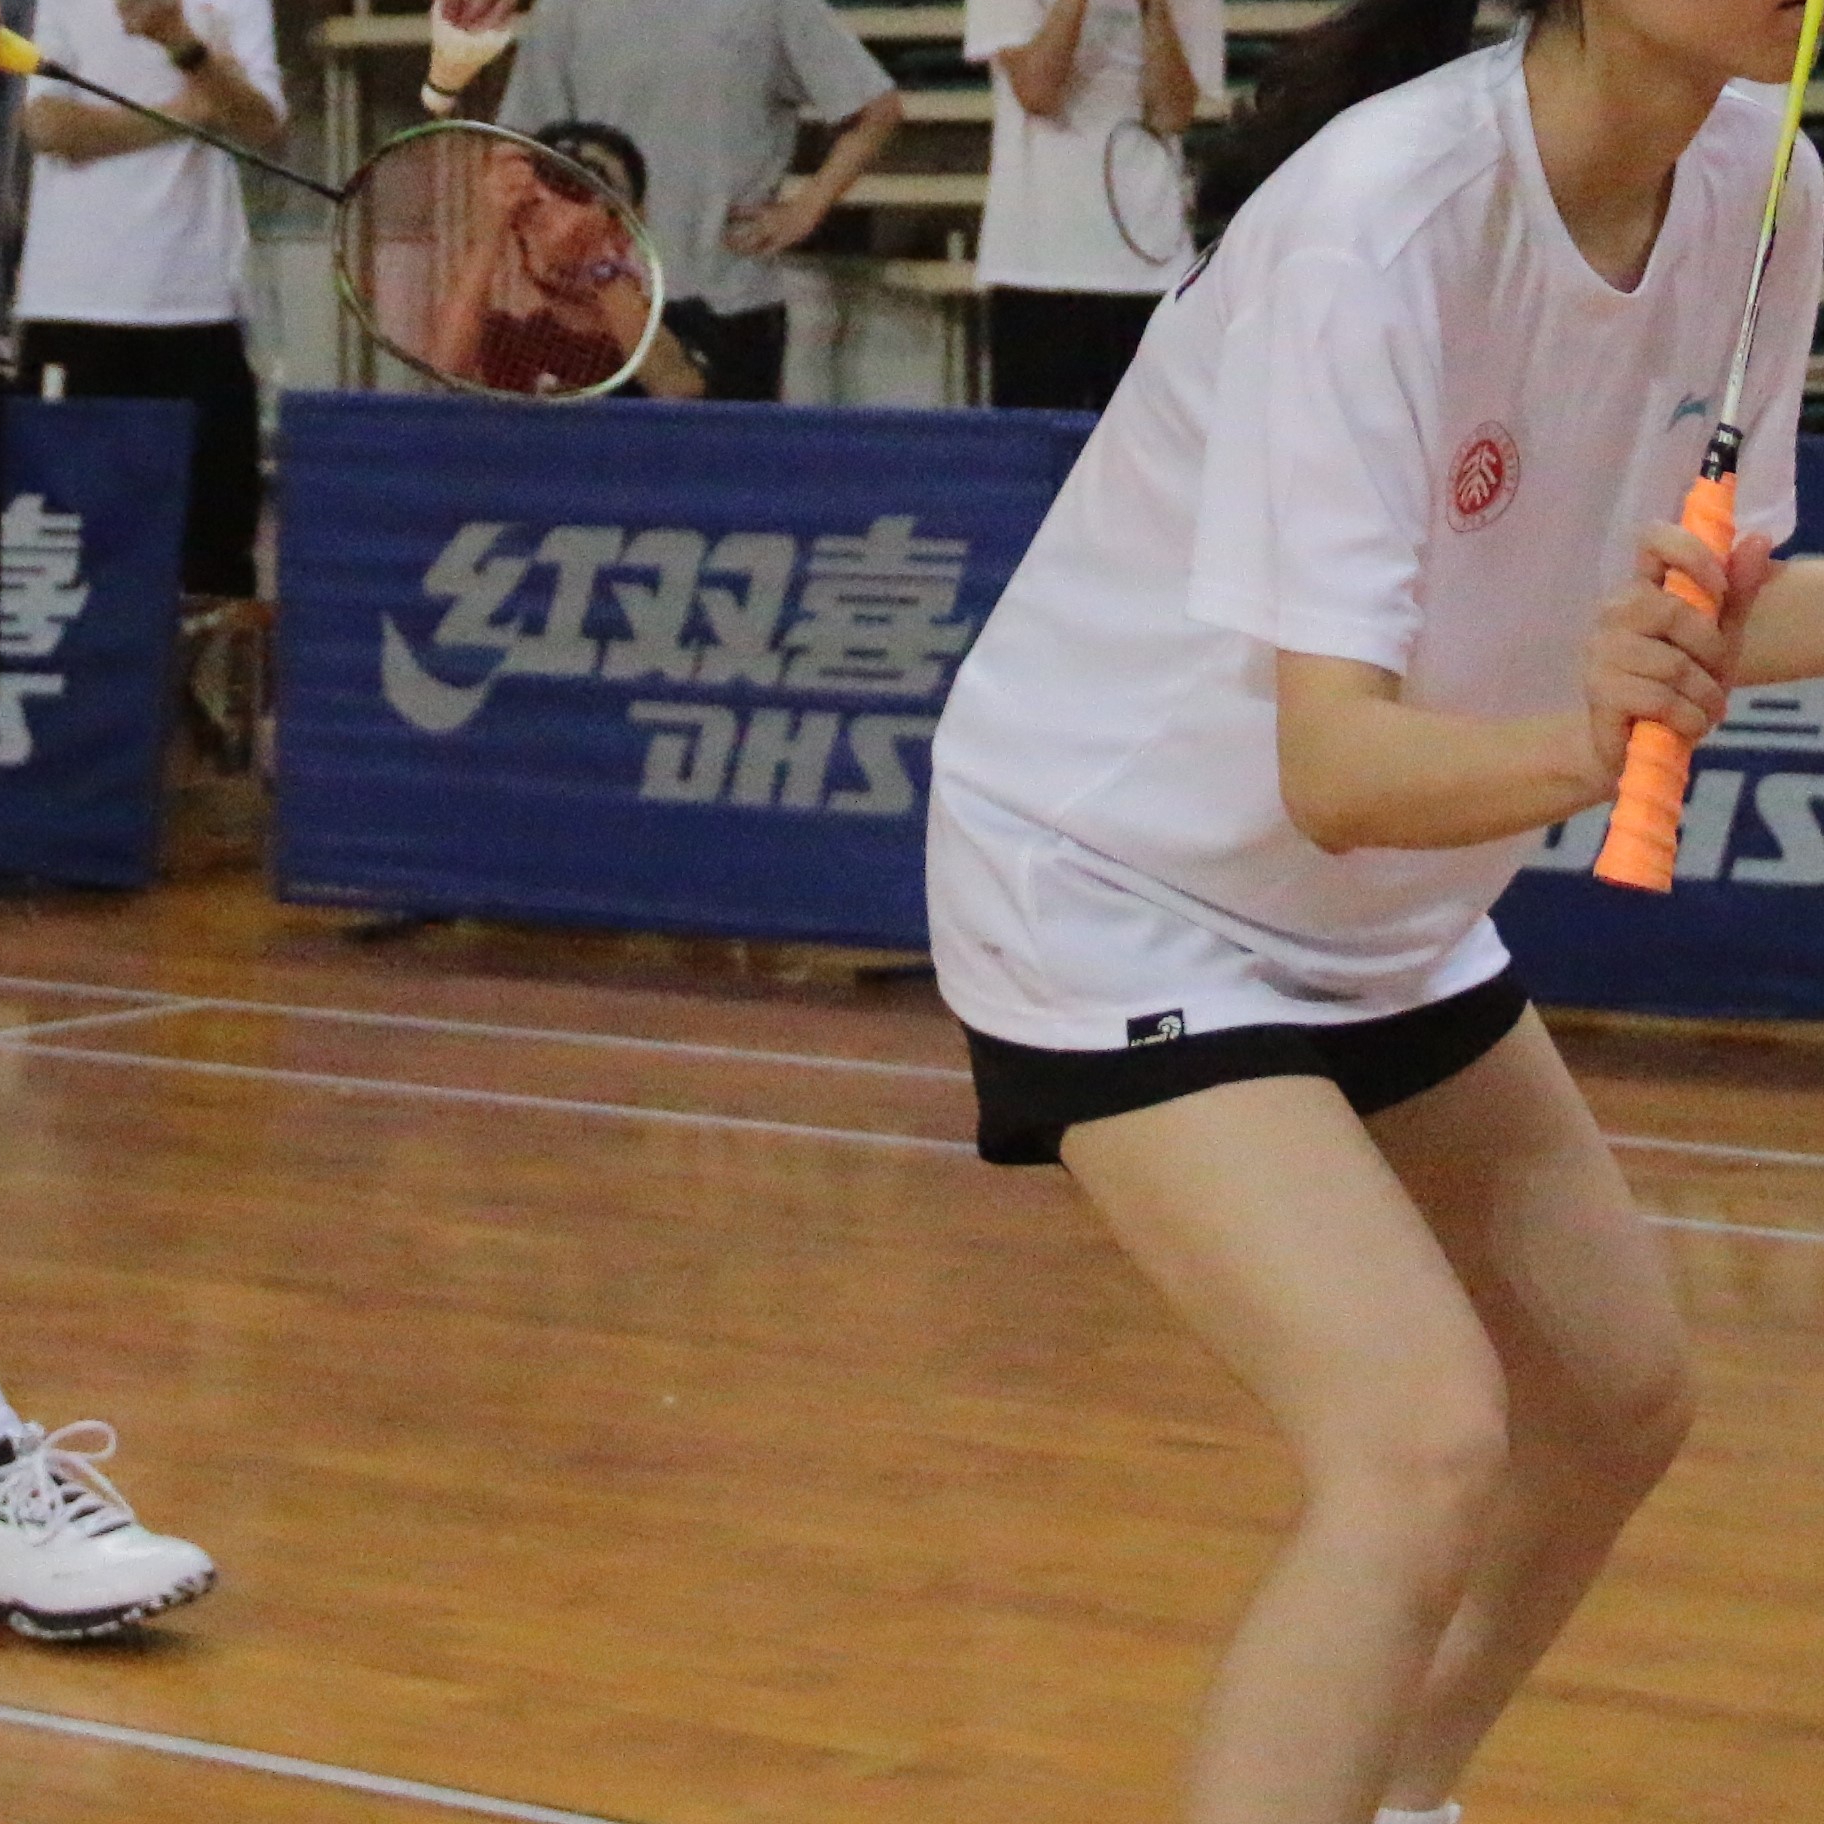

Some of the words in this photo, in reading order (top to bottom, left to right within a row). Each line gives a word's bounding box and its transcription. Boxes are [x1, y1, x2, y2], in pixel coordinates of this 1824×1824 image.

[380, 514, 976, 733] 红双喜
[627, 700, 938, 814] DHS
